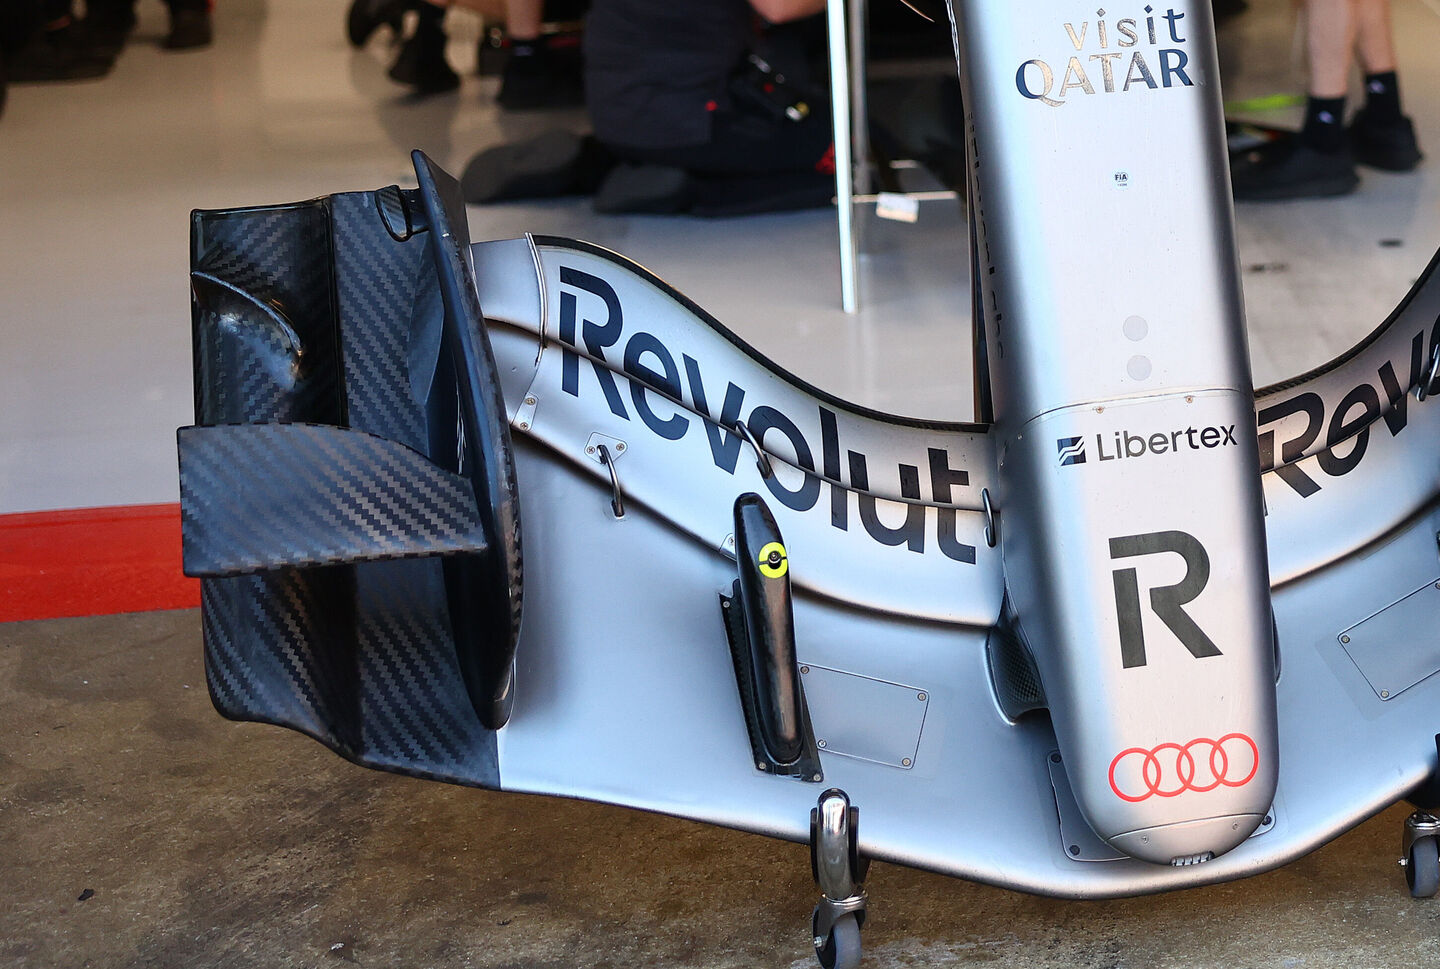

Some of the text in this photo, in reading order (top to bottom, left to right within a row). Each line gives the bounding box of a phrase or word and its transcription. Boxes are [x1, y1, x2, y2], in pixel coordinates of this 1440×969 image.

[1063, 4, 1187, 52] visit
[1015, 48, 1195, 108] QATAR
[1114, 173, 1128, 181] FIA
[559, 265, 977, 566] Revolut
[1096, 425, 1239, 462] Libertex
